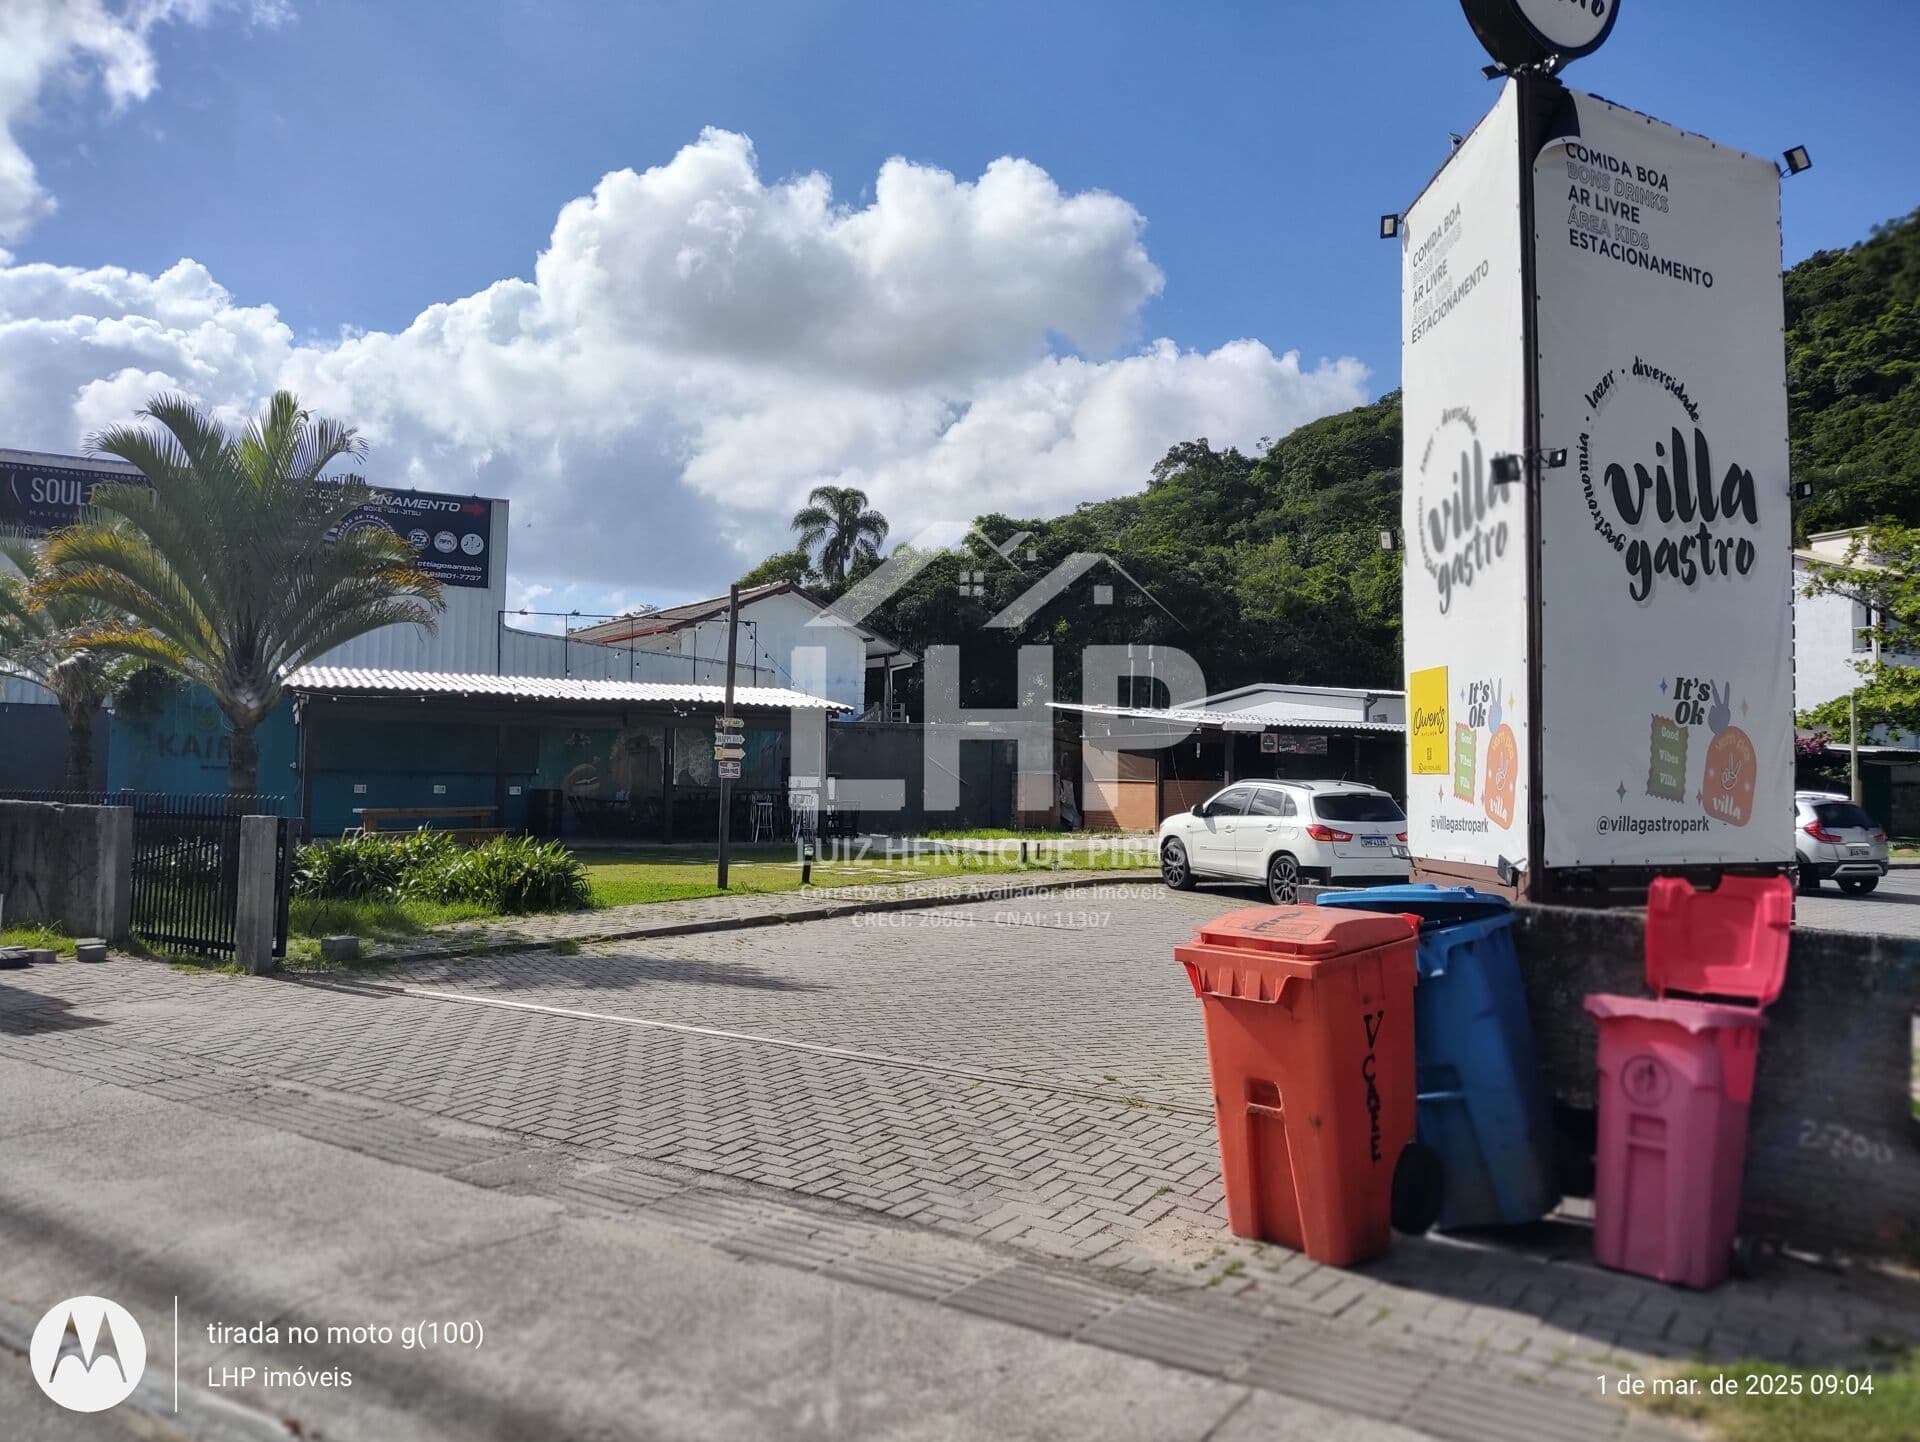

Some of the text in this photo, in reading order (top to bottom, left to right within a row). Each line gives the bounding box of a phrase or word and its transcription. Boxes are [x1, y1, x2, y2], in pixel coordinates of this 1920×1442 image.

[1566, 143, 1669, 192] COMIDA BOA
[1566, 161, 1670, 213] BONS DRINKS
[1567, 204, 1650, 250] ÁREA KIDS
[1568, 185, 1640, 224] AR LIVRE
[1413, 225, 1442, 268] COMIDA
[1444, 202, 1461, 232] BOA
[1569, 228, 1713, 288] ESTACIONAMENTO
[1412, 259, 1489, 344] ESTACIONAMENTO
[1413, 284, 1424, 306] AR
[1426, 259, 1448, 293] LIVRE
[1584, 355, 1699, 422] lazer diversidade
[1576, 432, 1627, 551] gastronomia
[1604, 426, 1758, 525] villa
[373, 494, 461, 512] INAMENTO
[1438, 521, 1508, 615] gastro
[1625, 522, 1755, 602] gastro
[1468, 680, 1490, 705] It's
[1673, 677, 1711, 701] It's
[1413, 705, 1445, 736] Owen's
[1469, 703, 1486, 728] Ok
[1661, 727, 1680, 741] Good
[1675, 700, 1705, 725] Ok
[1597, 815, 1710, 835] @villagastropark
[1712, 795, 1741, 820] villa
